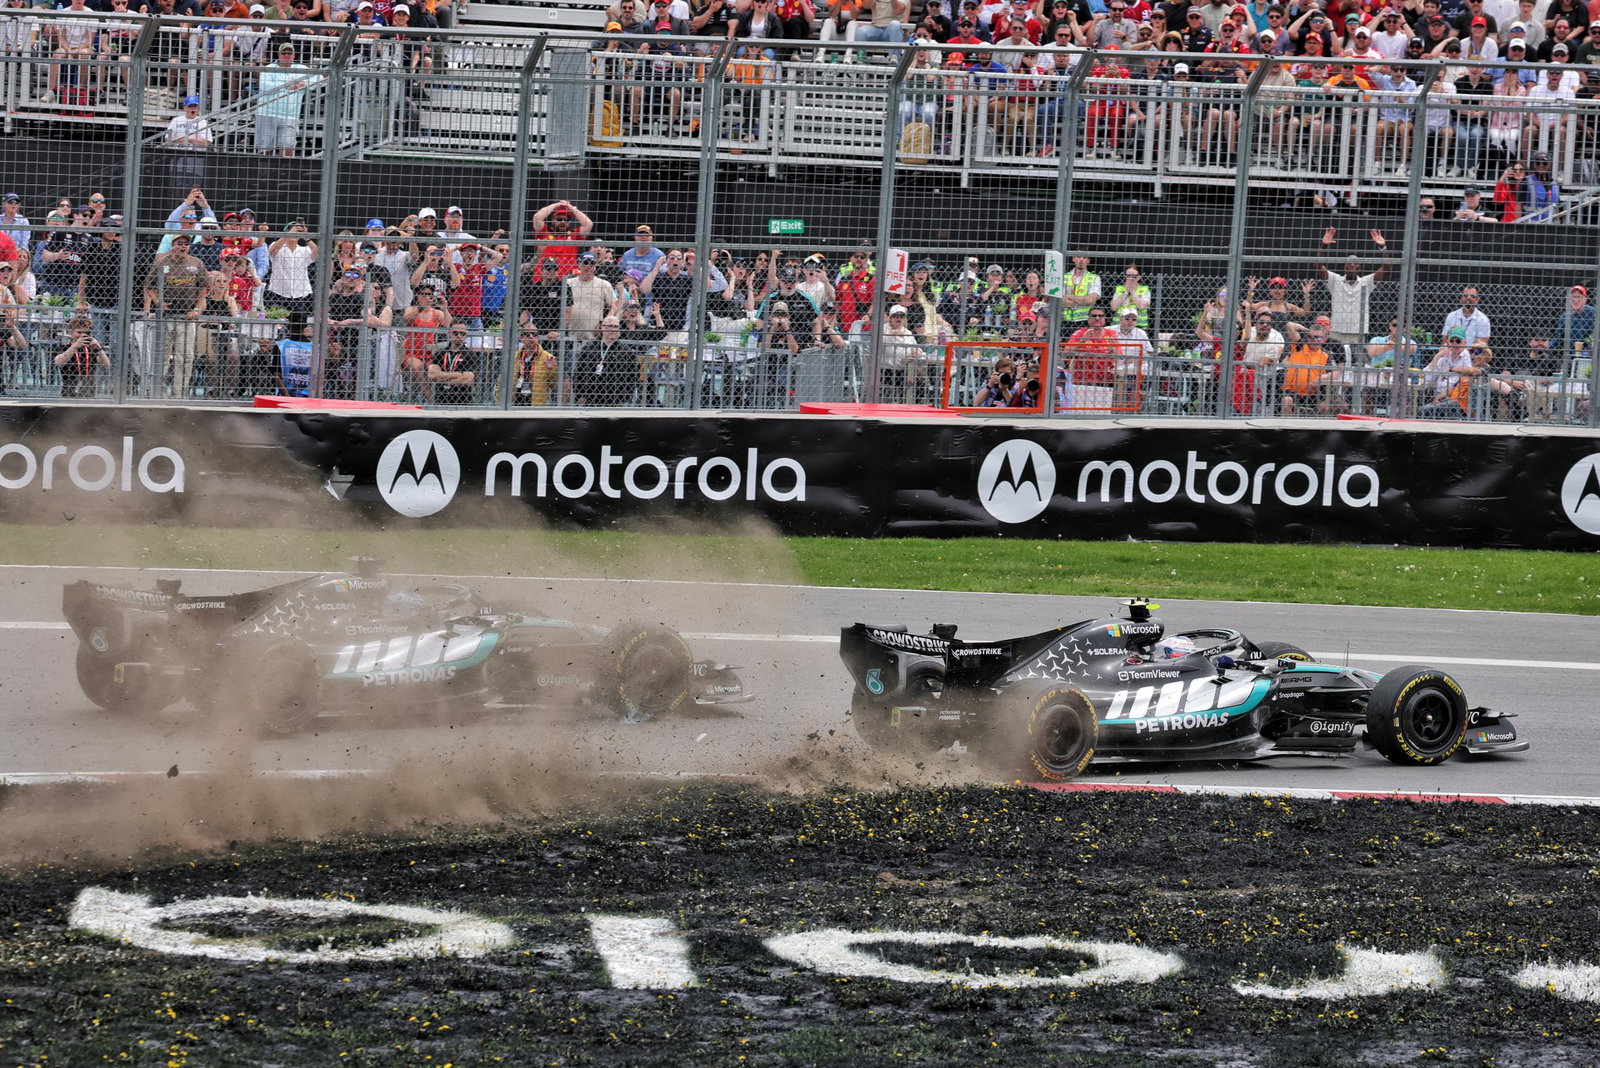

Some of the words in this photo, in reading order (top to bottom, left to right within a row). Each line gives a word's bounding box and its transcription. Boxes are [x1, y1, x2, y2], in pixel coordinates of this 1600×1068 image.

[780, 221, 802, 230] Exit
[886, 270, 905, 282] FIRE
[1045, 273, 1061, 285] EXIT
[486, 446, 805, 501] motorola
[1078, 451, 1379, 507] motorola
[348, 579, 388, 590] Microsoft
[177, 601, 226, 611] CROWDSTRIKE
[356, 625, 408, 634] TeamViewer
[1121, 623, 1160, 635] Microsoft
[872, 629, 951, 653] CROWDSTRIKE
[955, 648, 1002, 657] CROWDSTRIKE
[1093, 648, 1124, 656] SOLERA
[362, 665, 457, 688] PETRONAS
[1129, 669, 1180, 680] TeamViewer
[714, 684, 741, 693] Microsoft
[1134, 711, 1230, 734] PETRONAS
[1310, 721, 1354, 733] signify
[1486, 731, 1515, 740] Microsoft
[1396, 732, 1424, 762] ZERO
